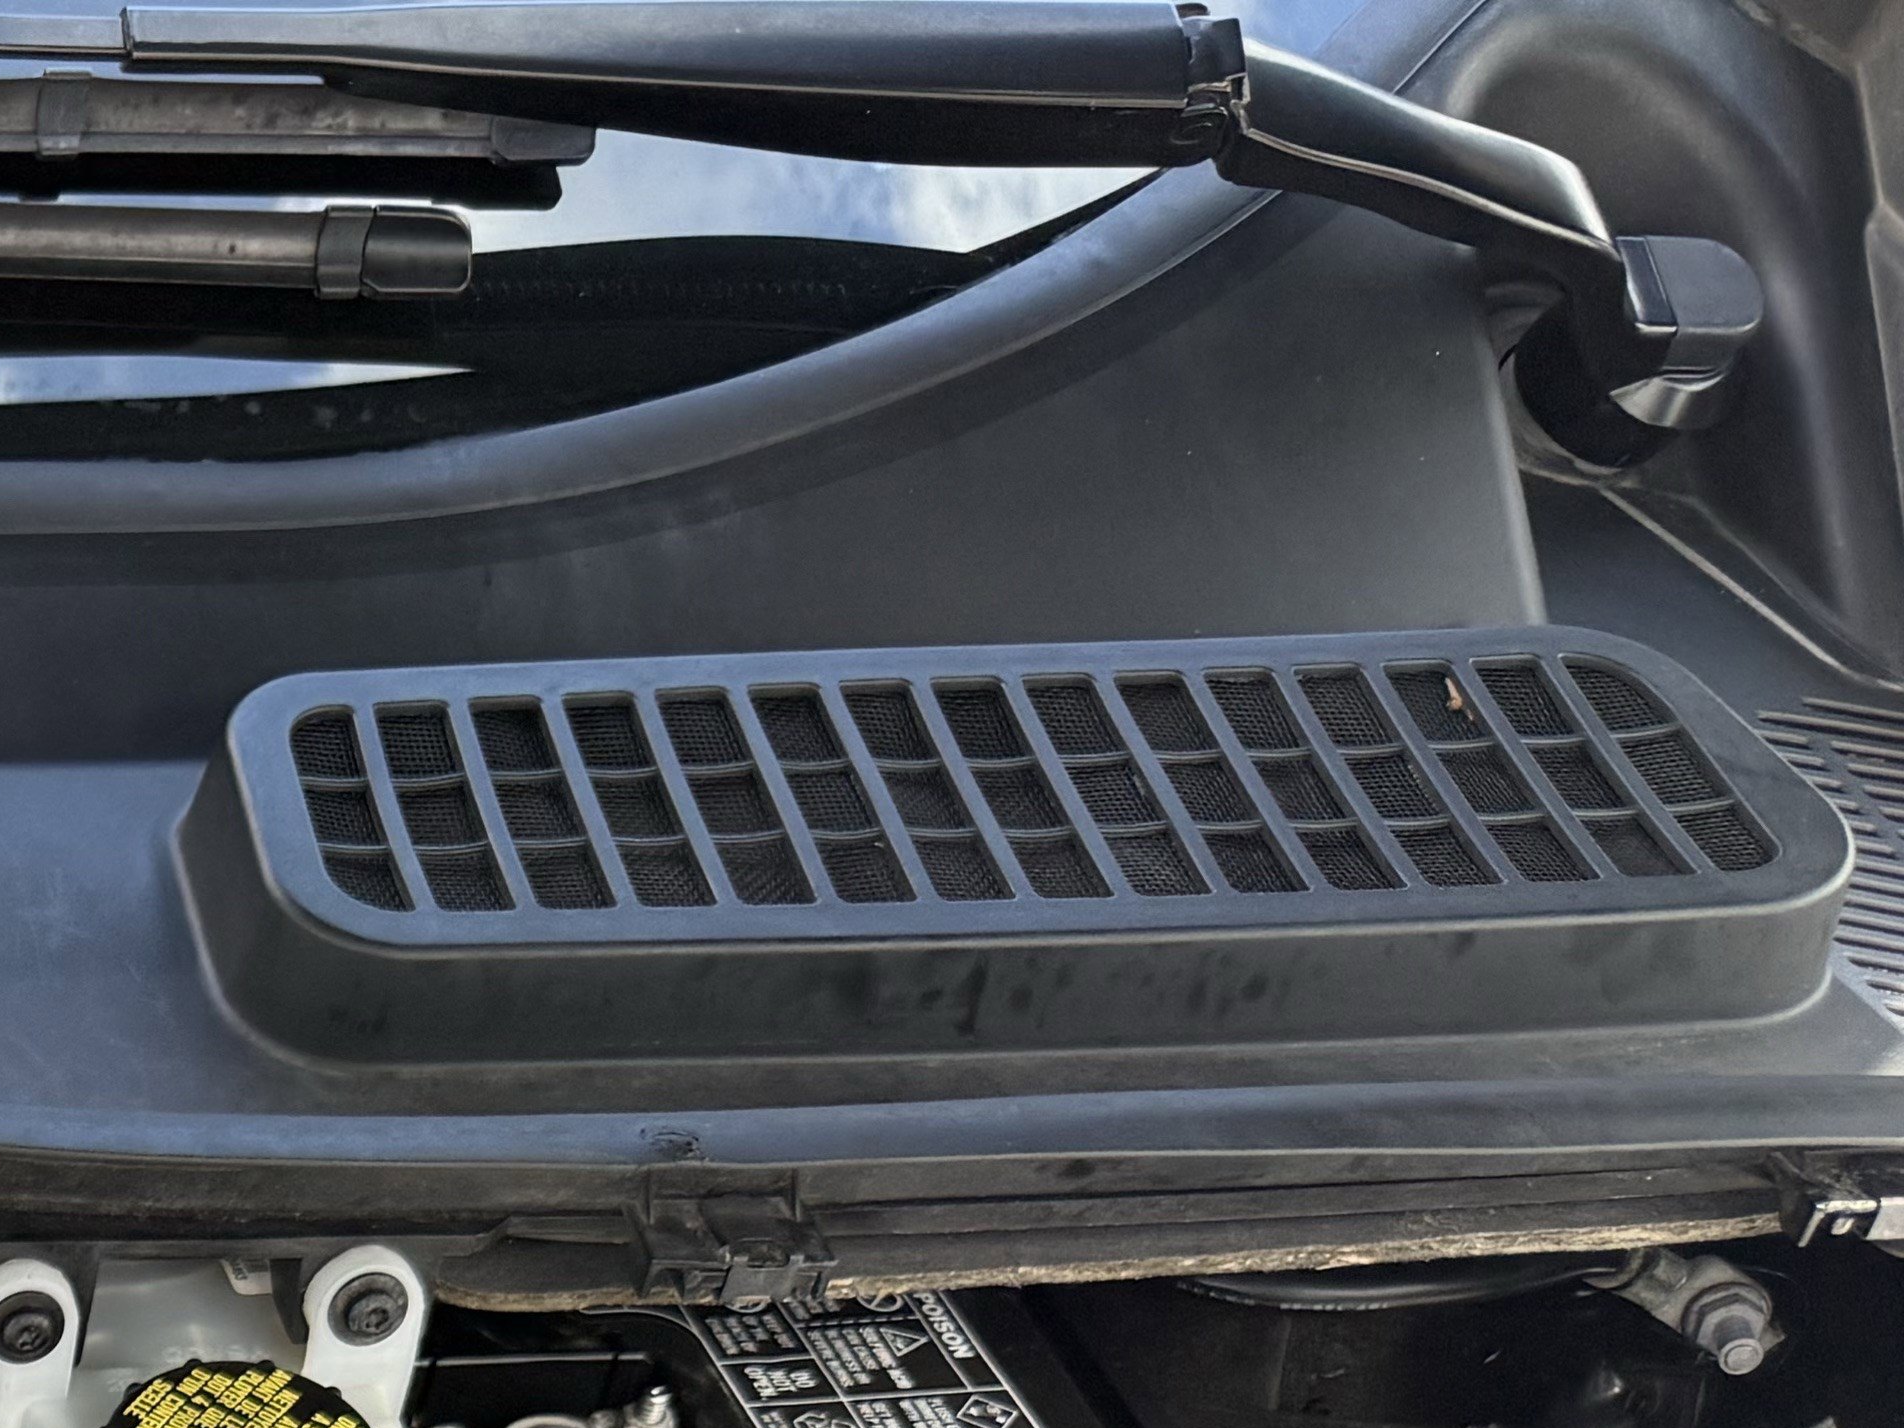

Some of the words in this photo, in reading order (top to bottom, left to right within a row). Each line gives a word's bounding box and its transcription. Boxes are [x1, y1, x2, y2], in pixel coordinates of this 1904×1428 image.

[912, 1291, 976, 1359] POISON
[202, 1373, 233, 1398] DOT
[216, 1370, 264, 1409] PLOYER
[251, 1368, 292, 1404] AVANT
[765, 1371, 796, 1392] NOT
[788, 1372, 818, 1387] DO
[190, 1395, 210, 1407] 4
[234, 1398, 261, 1419] DE
[310, 1412, 332, 1426] A
